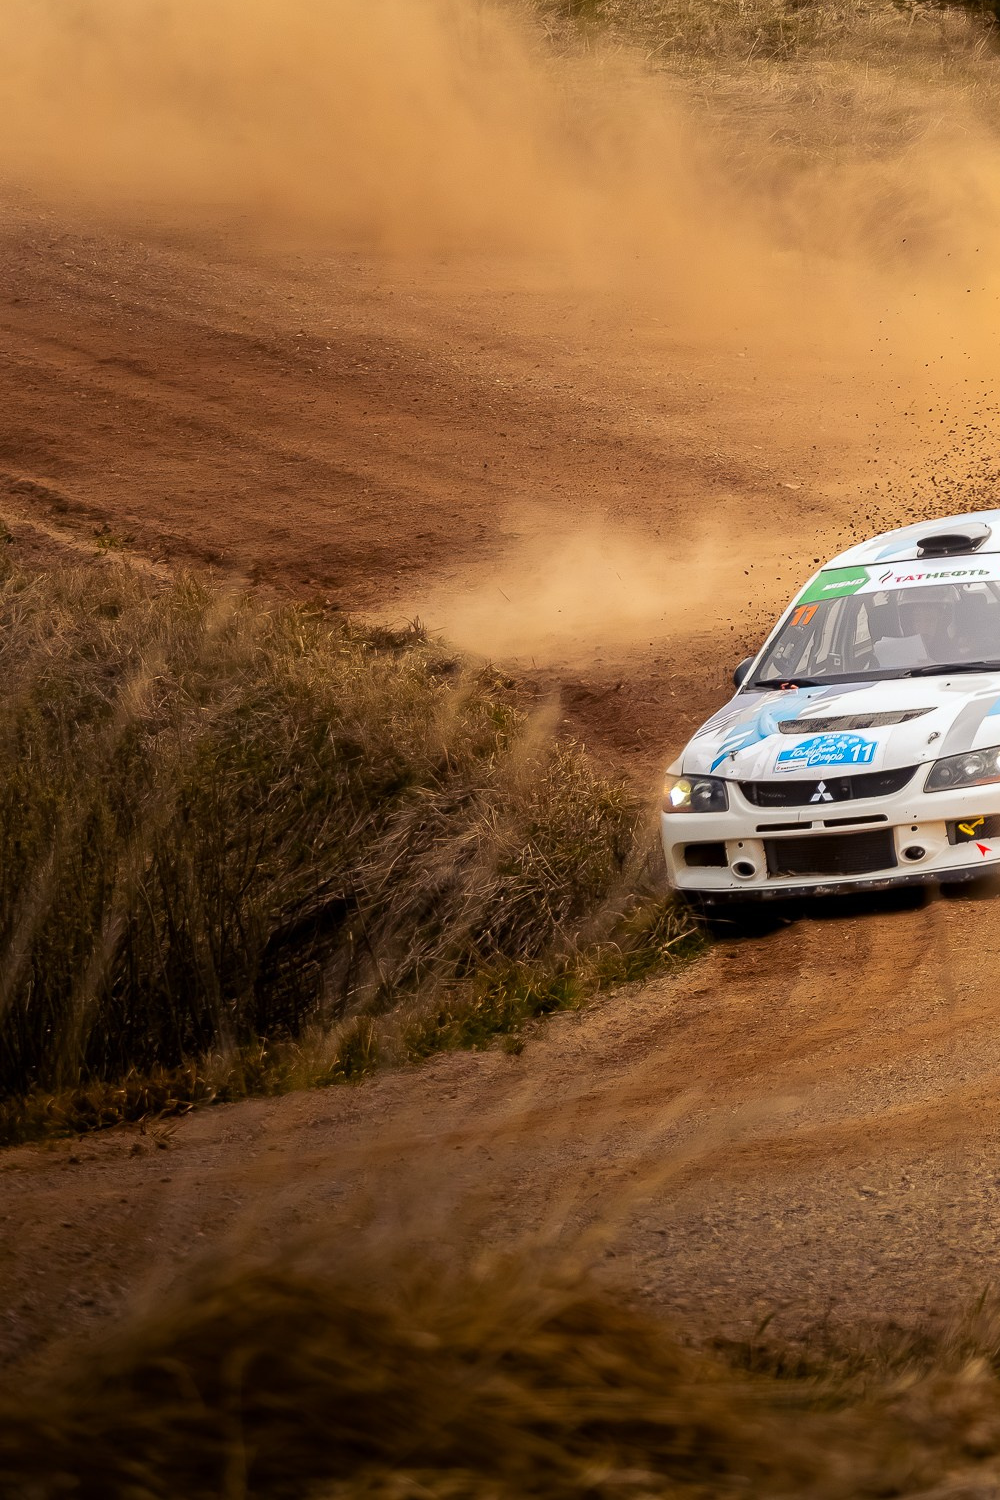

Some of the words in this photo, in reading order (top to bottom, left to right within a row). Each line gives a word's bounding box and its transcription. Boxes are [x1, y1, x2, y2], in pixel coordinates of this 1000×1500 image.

[894, 569, 990, 583] ТАТНЕФТЬ
[790, 604, 820, 626] 11
[850, 743, 875, 762] 11
